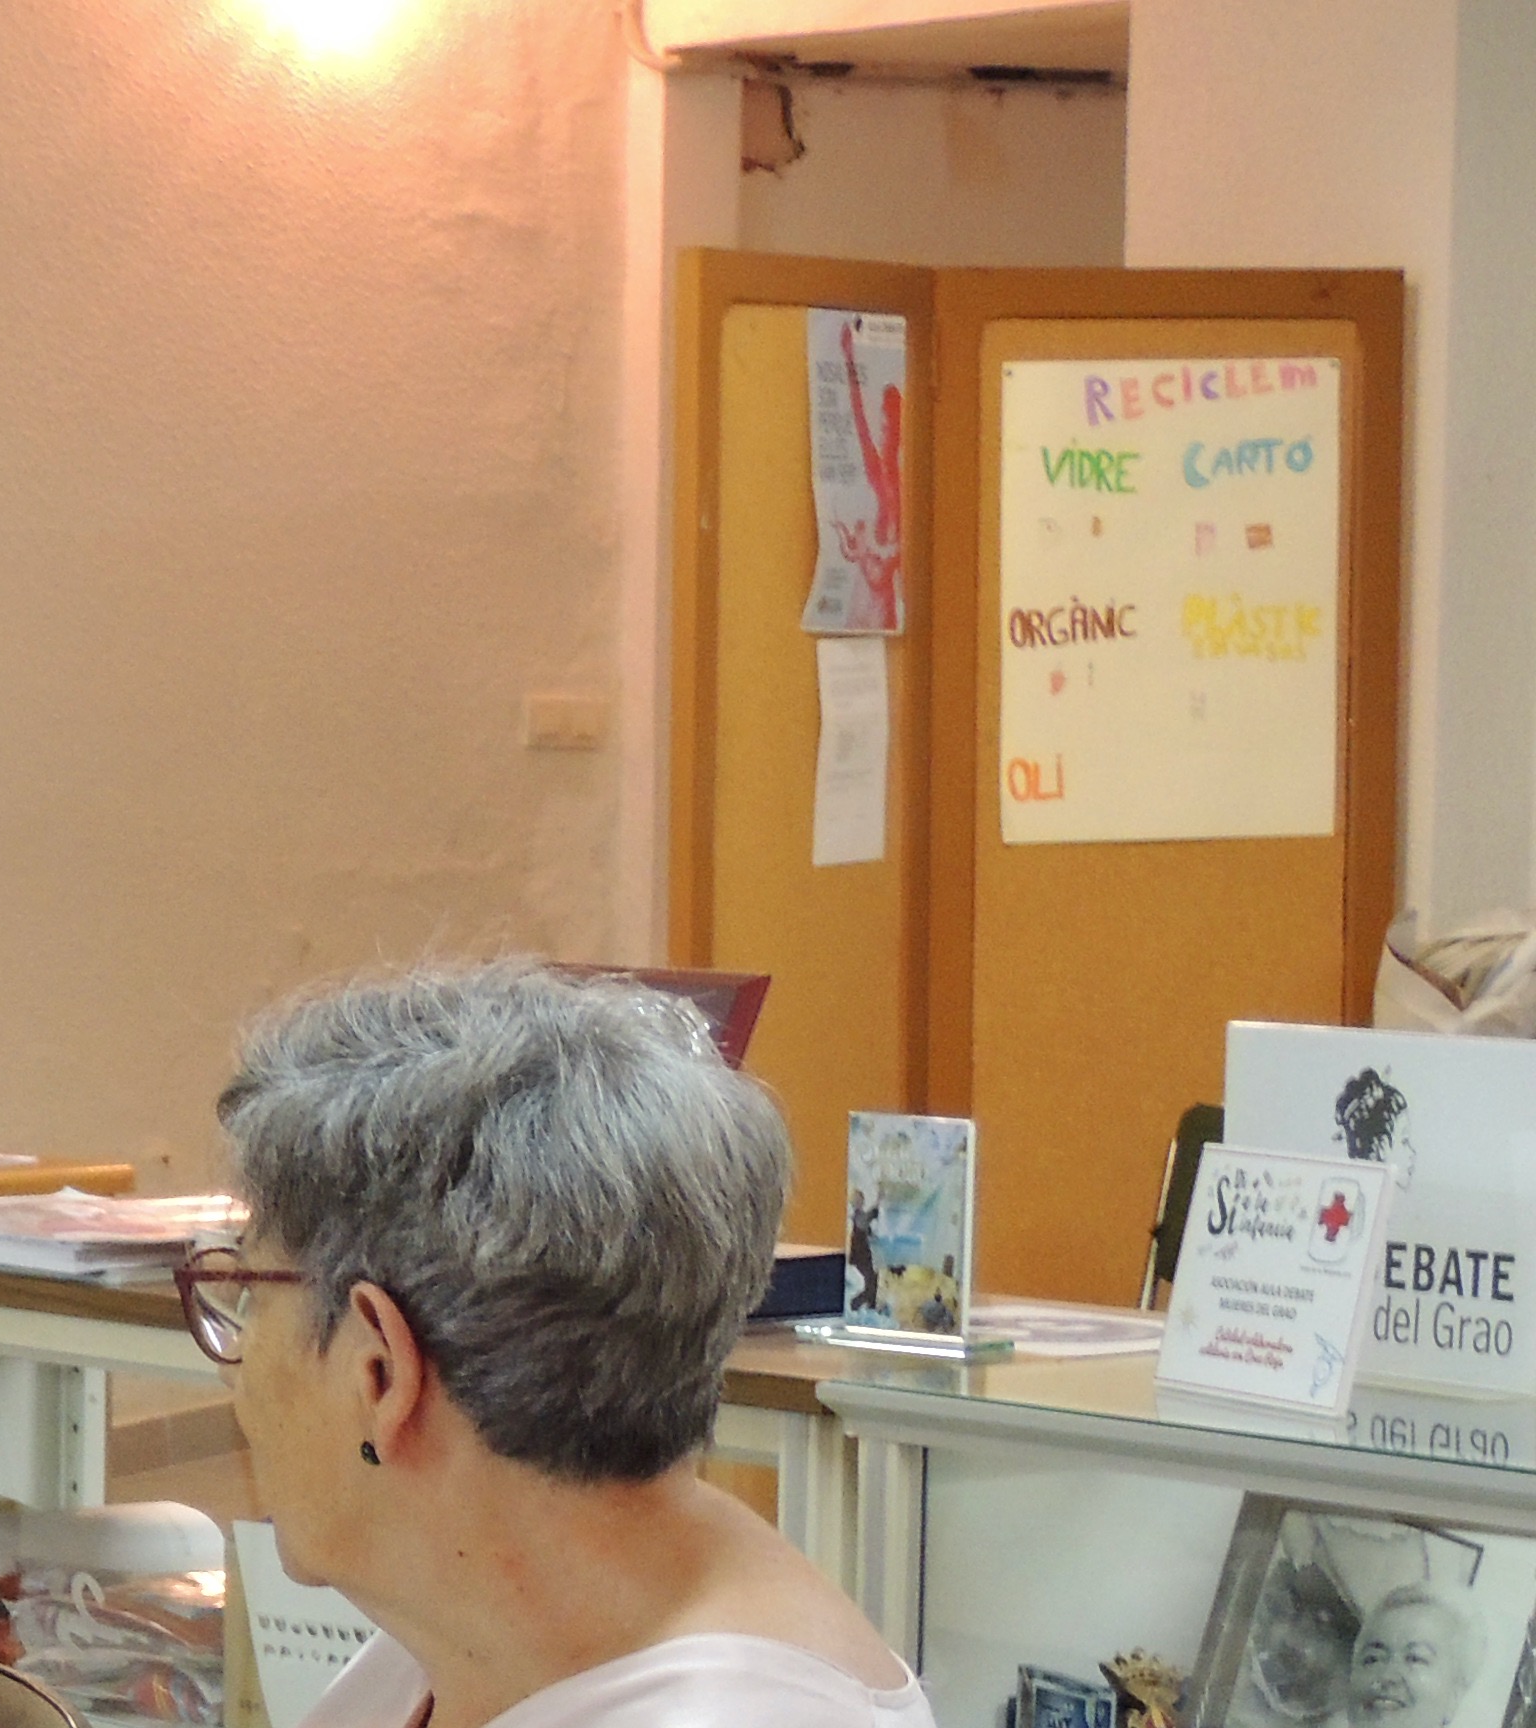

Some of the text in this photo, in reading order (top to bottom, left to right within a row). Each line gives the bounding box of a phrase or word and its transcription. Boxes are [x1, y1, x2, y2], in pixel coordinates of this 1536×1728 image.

[1383, 1241, 1515, 1302] EBATE
[1373, 1295, 1514, 1356] del Grao
